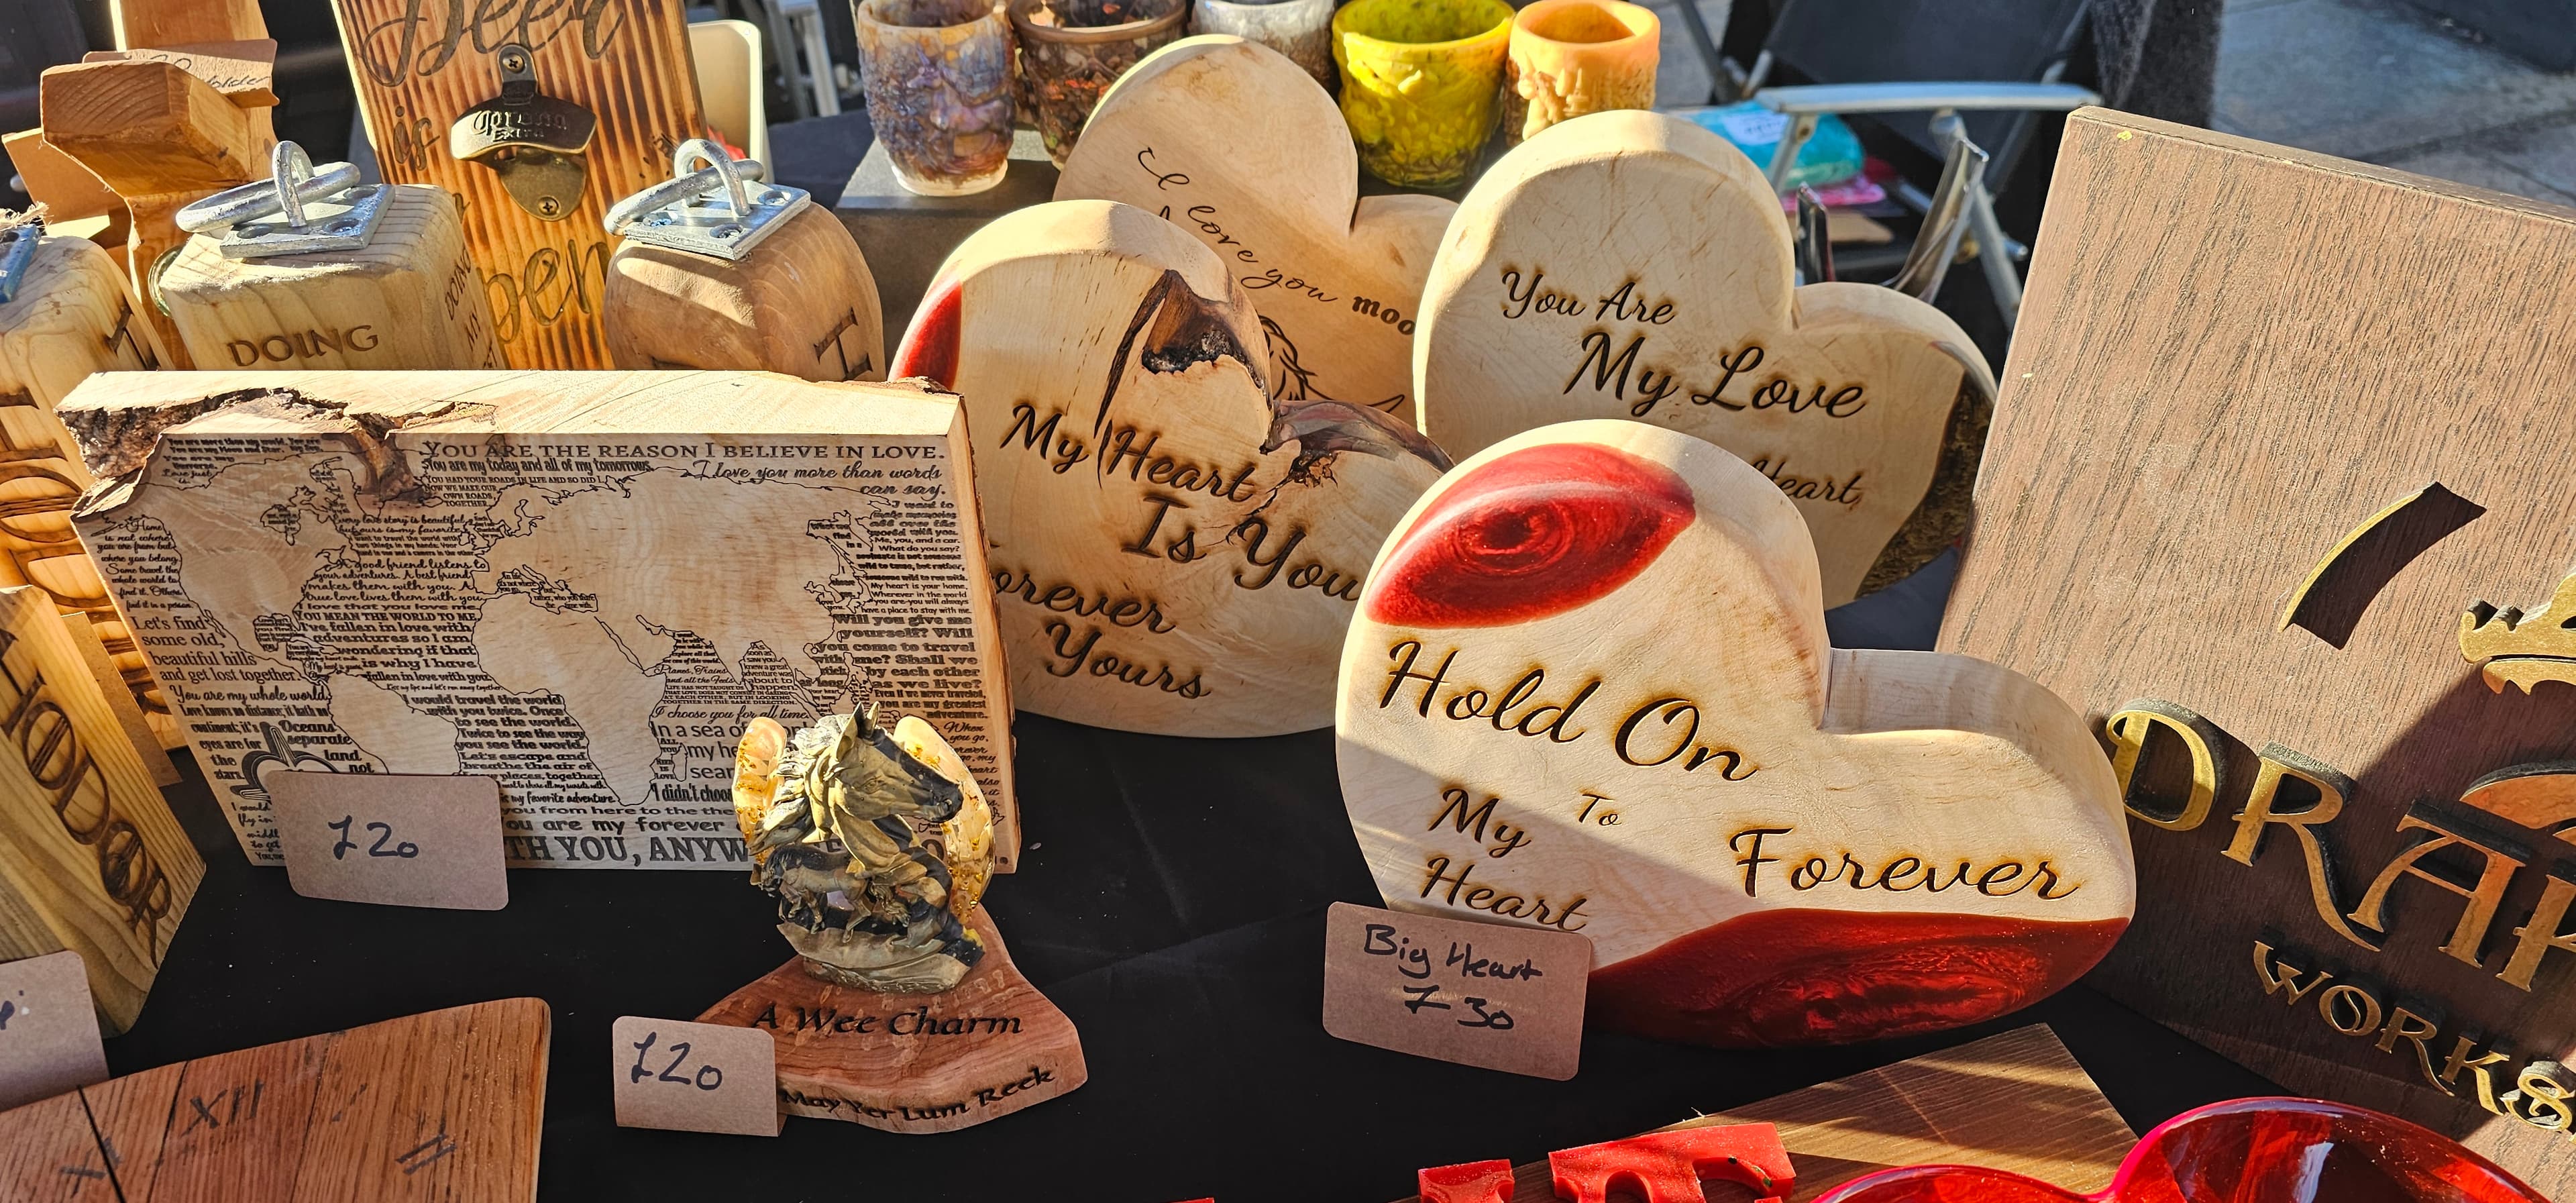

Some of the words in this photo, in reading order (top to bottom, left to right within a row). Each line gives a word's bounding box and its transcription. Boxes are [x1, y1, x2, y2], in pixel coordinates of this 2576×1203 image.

[1188, 205, 1258, 264] love
[1241, 269, 1338, 303] you
[474, 231, 612, 370] pen
[1501, 270, 1586, 319] You
[1595, 282, 1675, 325] Are
[227, 325, 378, 367] DOING
[1563, 332, 1679, 417] My
[1691, 347, 1868, 419] Love
[424, 441, 477, 458] YOU
[486, 445, 532, 458] ARE
[539, 446, 590, 458] THE
[598, 446, 699, 458] REASON
[706, 443, 716, 458] I
[723, 446, 828, 458] BELIEVE
[837, 446, 863, 458] IN
[1000, 404, 1089, 475] My
[1102, 428, 1258, 503] Heart
[427, 458, 447, 470] You
[449, 462, 468, 470] are
[469, 462, 486, 475] my
[487, 458, 521, 475] today
[522, 458, 543, 470] and
[545, 458, 559, 470] all
[561, 458, 574, 470] of
[576, 462, 593, 475] my
[715, 462, 751, 478] love
[755, 469, 788, 483] you
[794, 468, 837, 479] more
[843, 461, 883, 479] than
[889, 464, 942, 480] words
[860, 484, 898, 495] can
[1122, 495, 1207, 564] Is
[307, 580, 352, 591] makes
[352, 580, 390, 591] them
[392, 580, 425, 591] with
[989, 564, 1176, 634] orever
[134, 616, 170, 630] Let's
[173, 616, 207, 630] find
[294, 611, 322, 621] YOU
[323, 611, 363, 621] MEAN
[364, 611, 388, 621] THE
[390, 612, 436, 621] WORLD
[437, 612, 455, 621] TO
[834, 615, 869, 625] Will
[874, 617, 906, 627] you
[908, 615, 943, 627] give
[948, 617, 972, 625] me
[331, 622, 377, 632] fallen
[379, 622, 397, 632] in
[397, 622, 431, 632] love
[433, 622, 472, 632] with
[841, 628, 928, 639] yourself?
[932, 628, 973, 639] Will
[143, 635, 186, 645] some
[191, 633, 225, 648] old,
[818, 643, 848, 653] you
[853, 643, 897, 651] come
[901, 643, 919, 651] to
[922, 642, 975, 652] travel
[148, 651, 218, 666] beautiful
[224, 651, 258, 666] hills
[1044, 623, 1212, 699] Yours
[160, 668, 184, 680] and
[189, 670, 210, 684] get
[213, 668, 237, 680] lost
[170, 685, 201, 702] You
[203, 692, 225, 701] are
[227, 692, 248, 704] my
[250, 686, 287, 700] whole
[411, 694, 453, 704] would
[455, 694, 496, 704] travel
[498, 694, 521, 704] the
[523, 694, 562, 704] world
[667, 704, 706, 719] choose
[708, 711, 733, 725] you
[735, 705, 757, 725] for
[760, 705, 777, 719] all
[1379, 641, 1602, 745] Hold
[1615, 697, 1762, 782] On
[278, 720, 337, 733] Oceans
[651, 721, 670, 737] In
[674, 725, 686, 737] a
[692, 725, 724, 737] sea
[729, 722, 746, 737] of
[287, 733, 353, 748] separate
[325, 749, 362, 761] land
[349, 762, 374, 772] not
[539, 806, 594, 815] from
[598, 806, 636, 815] here
[642, 806, 661, 815] to
[664, 806, 698, 815] the
[1580, 793, 1622, 826] To
[543, 820, 582, 831] are
[592, 820, 625, 834] my
[636, 817, 724, 833] forever
[1428, 788, 1532, 858] My
[328, 815, 419, 860] £20
[1729, 828, 2080, 900] Forever
[1421, 857, 1592, 933] Heart
[1364, 924, 1431, 979] Big
[1446, 943, 1542, 980] Heart
[751, 1006, 782, 1031] A
[798, 1008, 880, 1034] Wee
[888, 1006, 1023, 1036] Charm
[2254, 940, 2575, 1131] WORKS
[631, 1032, 723, 1092] £20
[780, 1090, 841, 1113] May
[847, 1098, 895, 1121] Yer
[900, 1095, 970, 1122] Lum
[977, 1068, 1056, 1108] Reek
